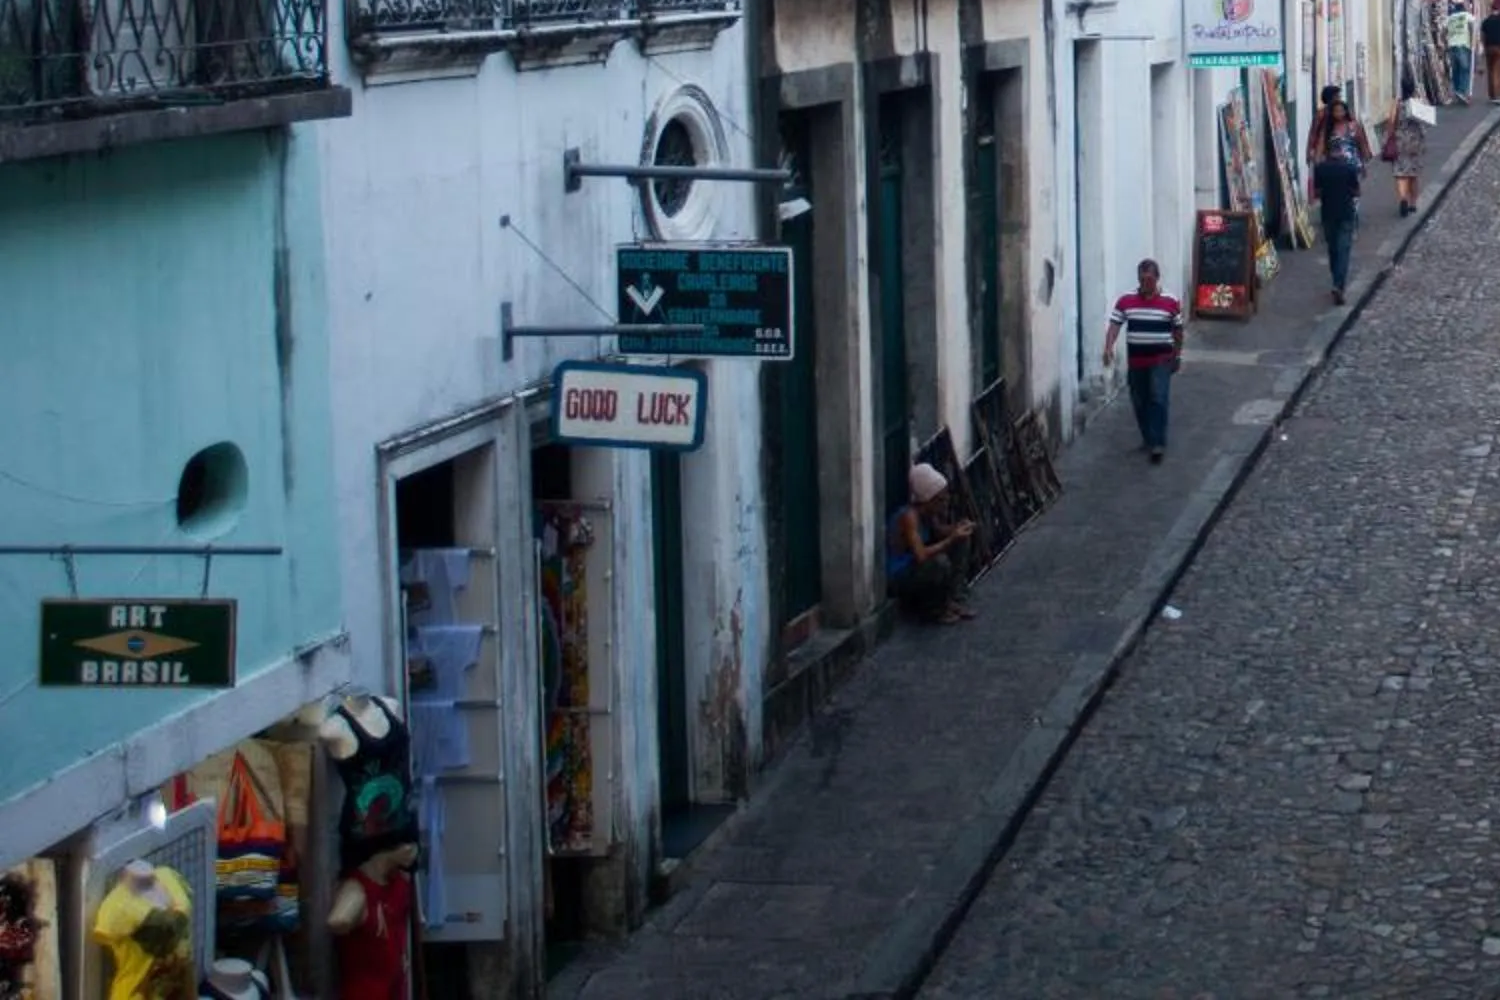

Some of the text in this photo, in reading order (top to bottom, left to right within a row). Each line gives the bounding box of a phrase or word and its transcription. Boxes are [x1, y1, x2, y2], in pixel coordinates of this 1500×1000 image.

[621, 253, 787, 273] SOCIEDADE BENEFICENTE
[566, 388, 692, 426] GOOD LUCK
[111, 605, 167, 628] ART
[81, 660, 190, 683] BRASIL
